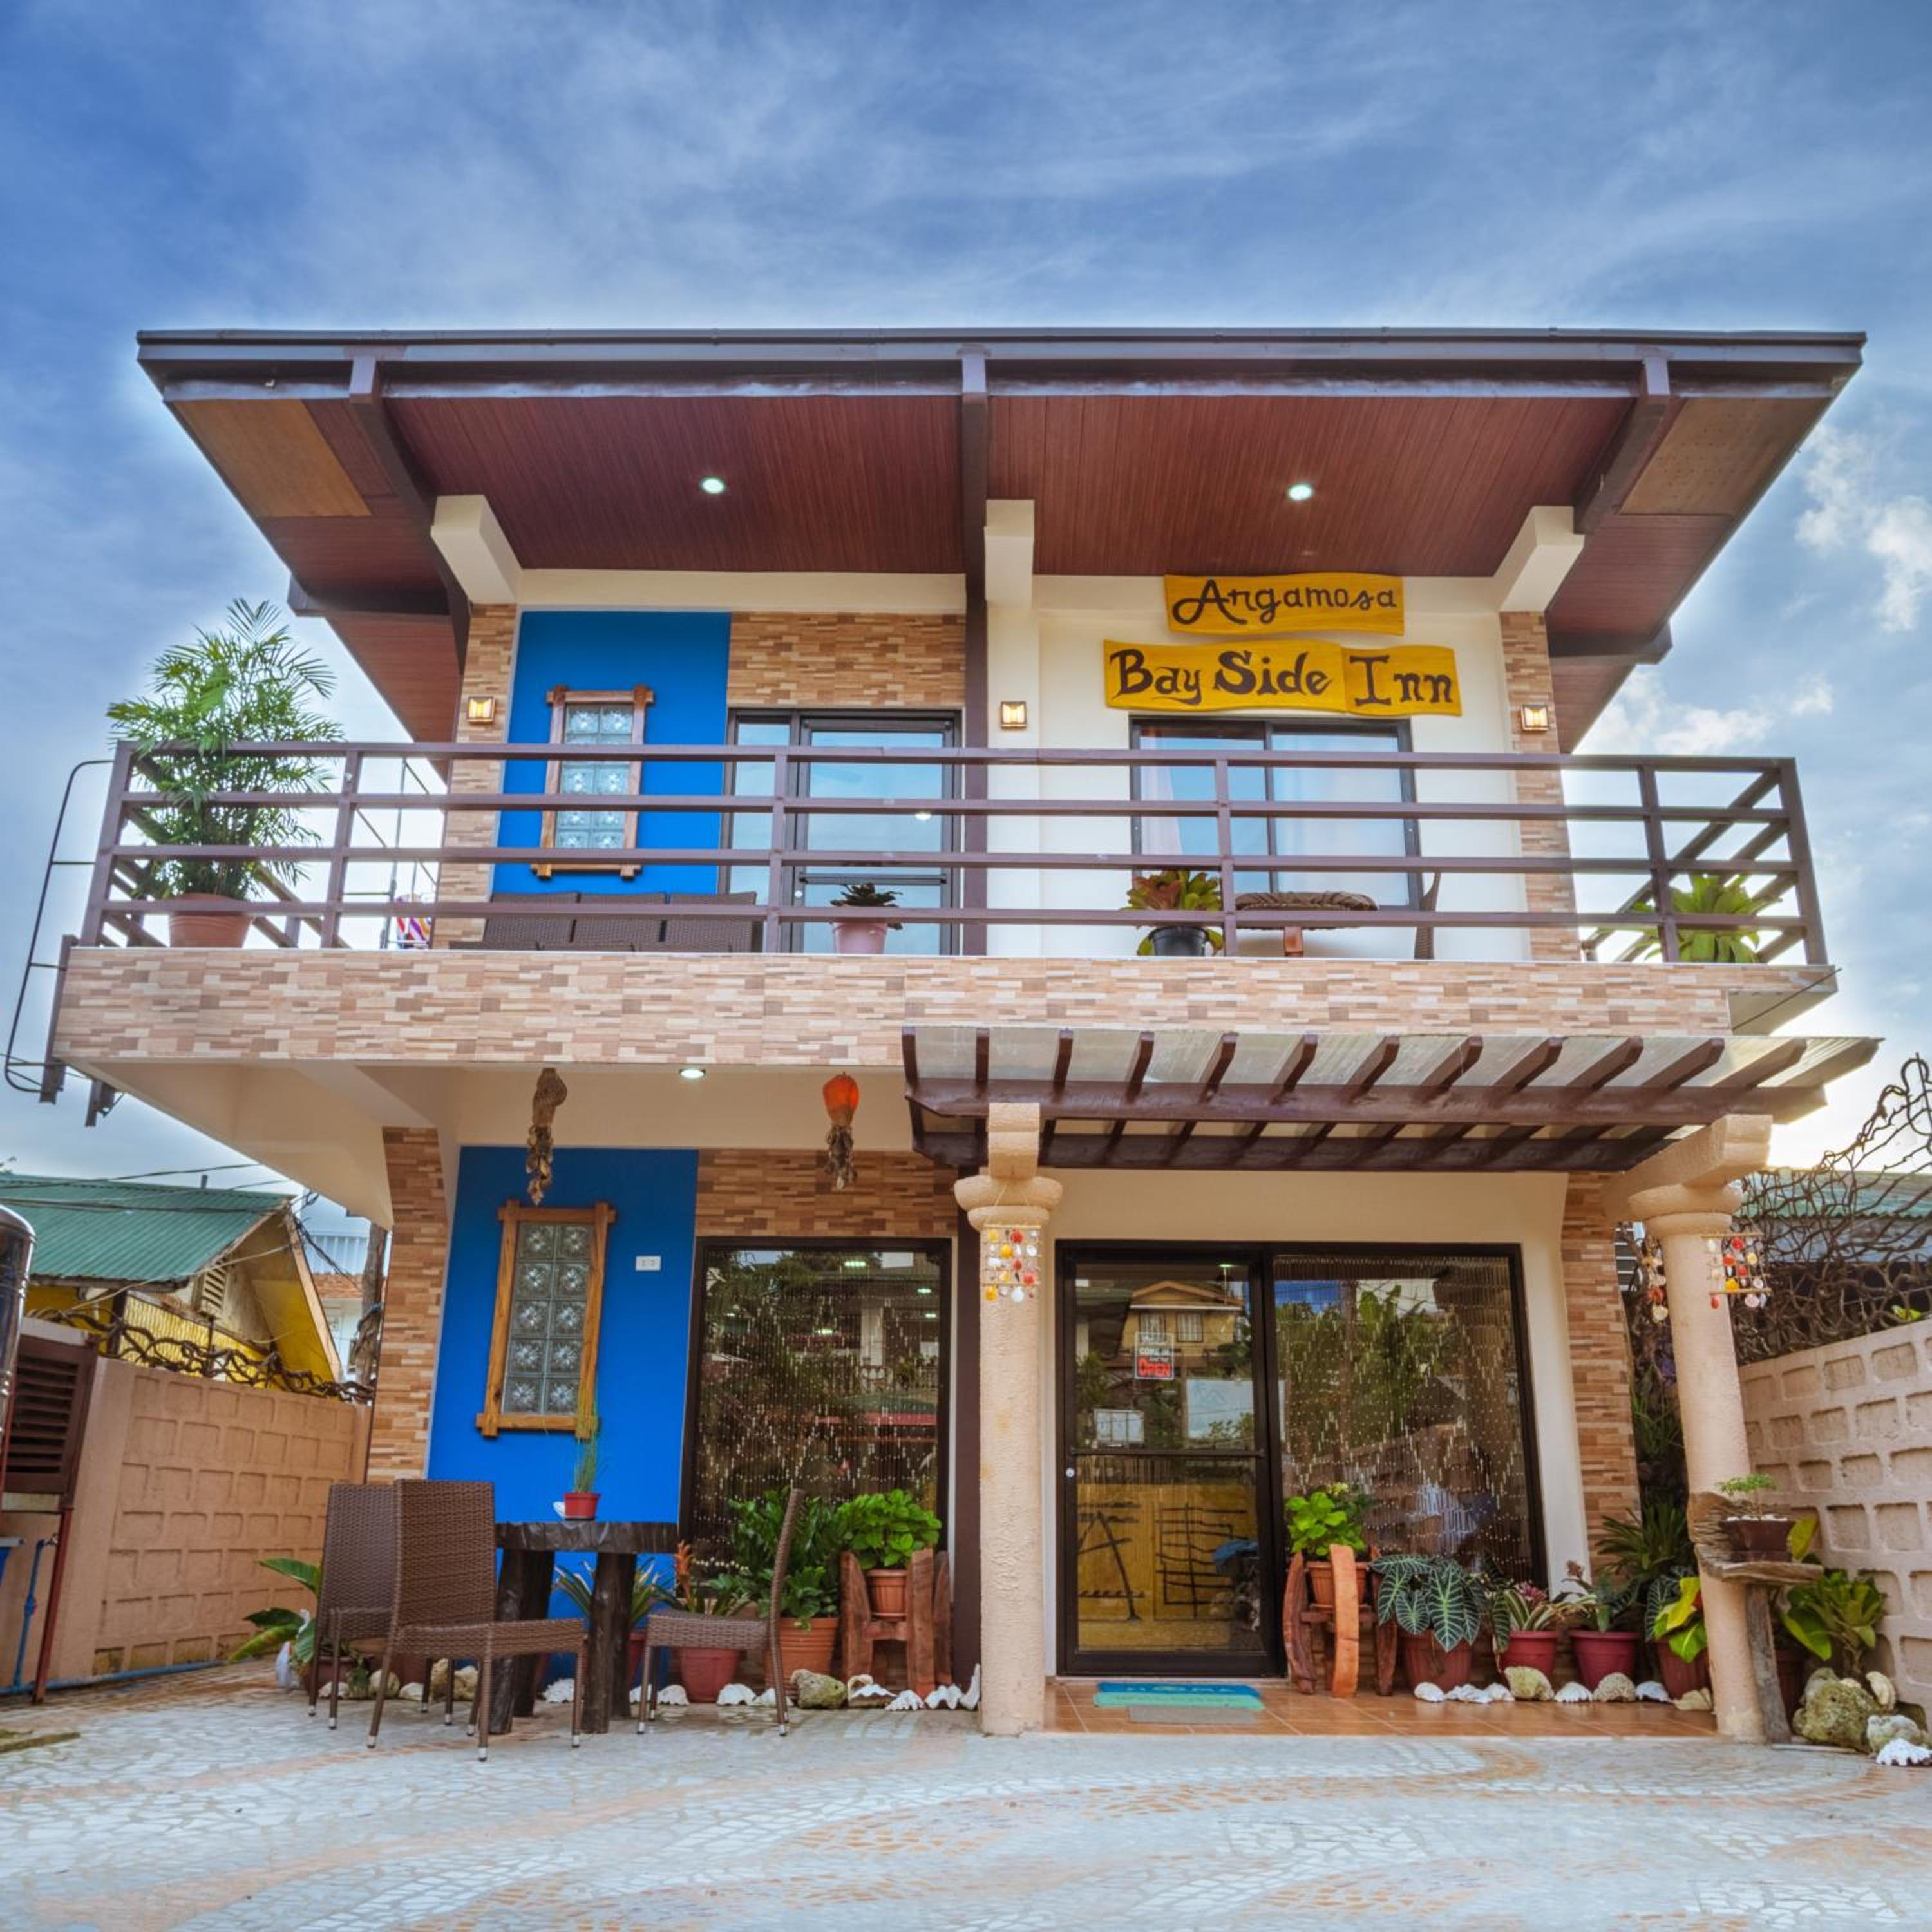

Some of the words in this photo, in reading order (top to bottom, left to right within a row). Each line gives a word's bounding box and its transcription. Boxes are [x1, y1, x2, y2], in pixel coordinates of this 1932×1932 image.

[1171, 579, 1397, 625] Argamosa
[1110, 649, 1202, 706] Bay
[1213, 650, 1332, 696] Side
[1350, 655, 1454, 706] Inn
